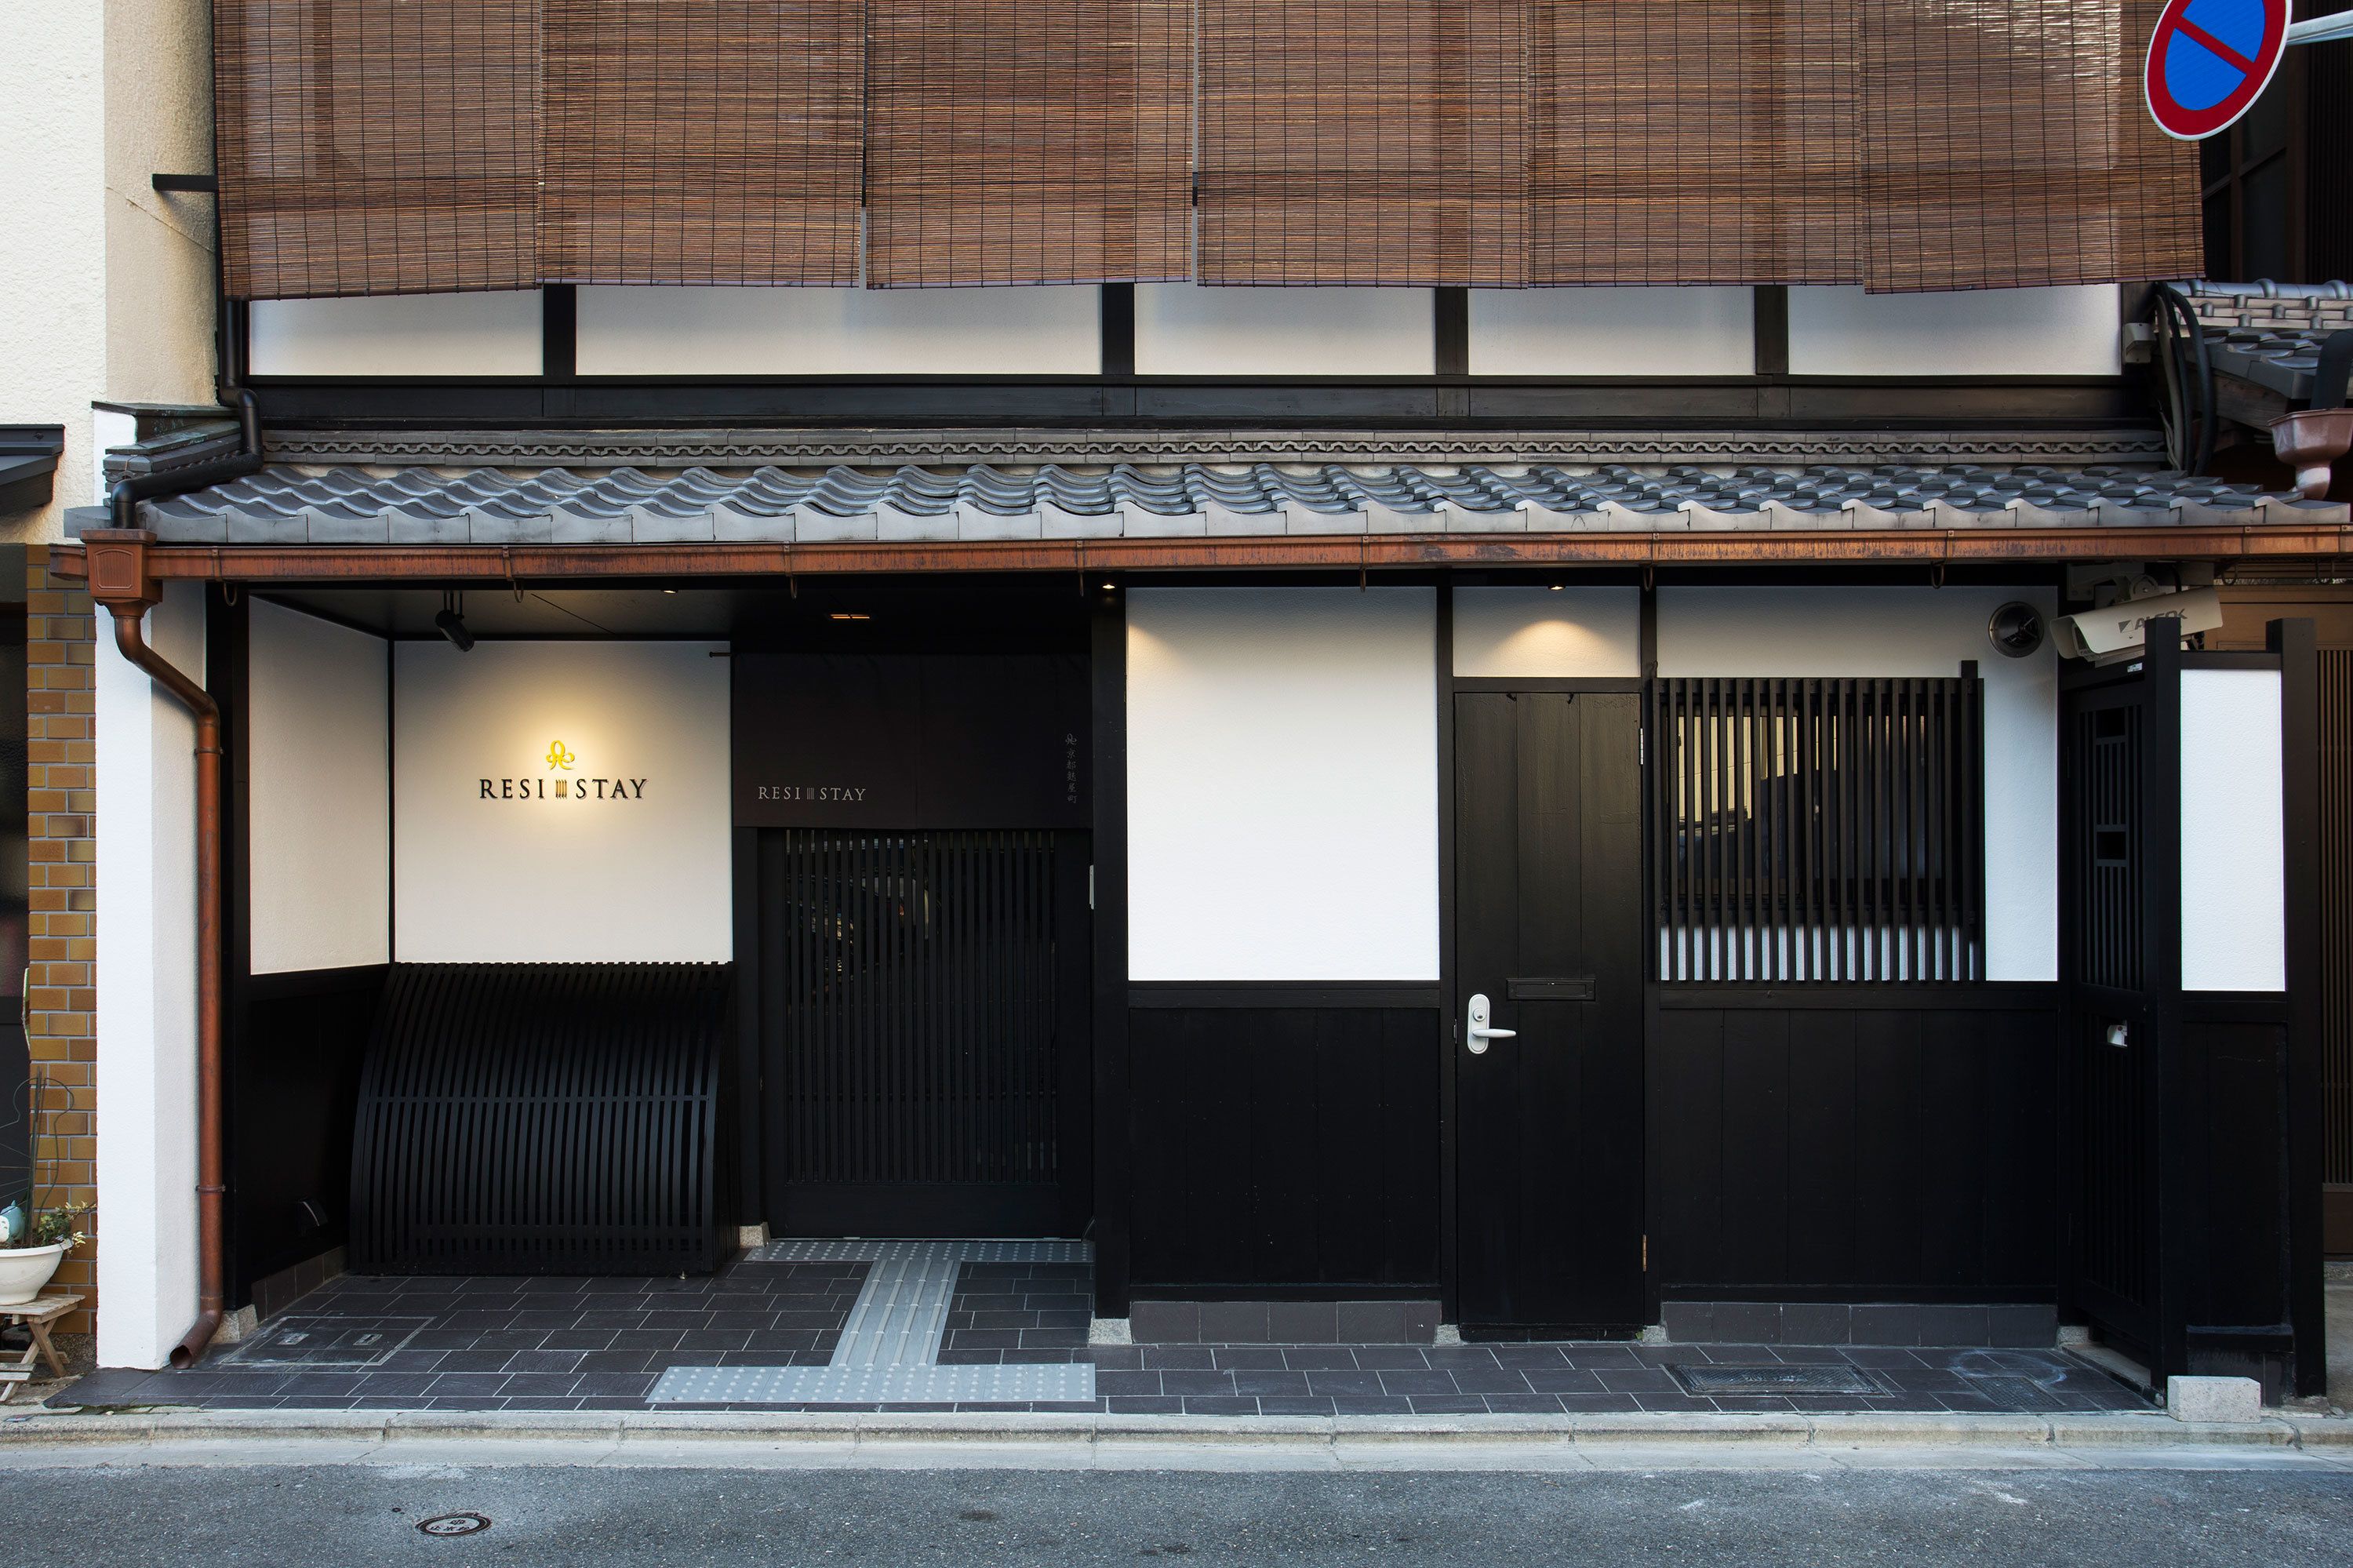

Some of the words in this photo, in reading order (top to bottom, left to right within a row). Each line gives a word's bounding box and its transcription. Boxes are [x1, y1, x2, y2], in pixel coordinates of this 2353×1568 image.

[480, 779, 544, 799] RESI
[576, 778, 648, 799] STAY
[758, 786, 801, 800] RESI
[820, 787, 867, 801] STAY
